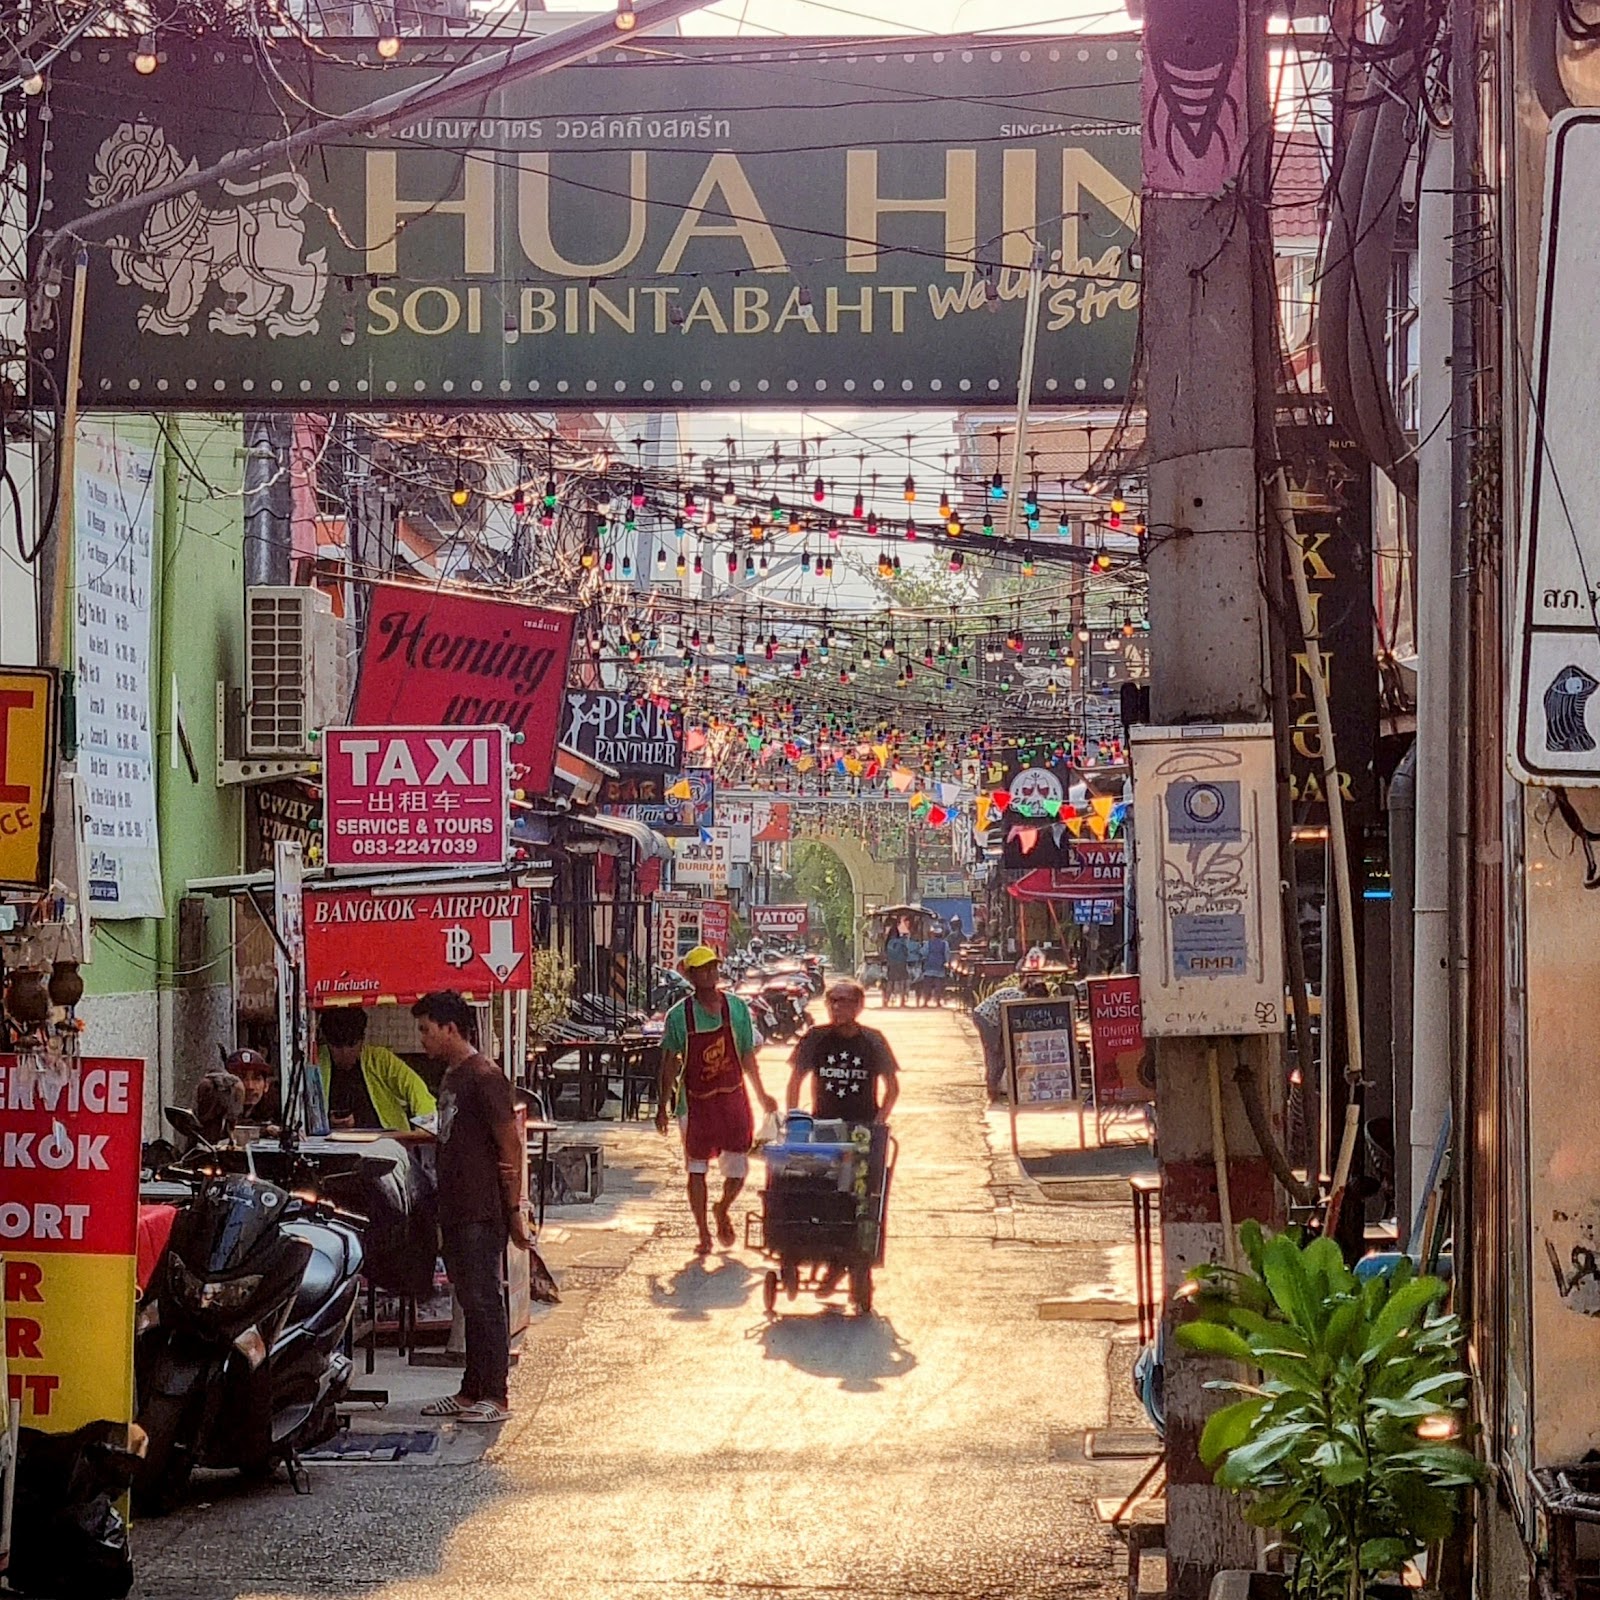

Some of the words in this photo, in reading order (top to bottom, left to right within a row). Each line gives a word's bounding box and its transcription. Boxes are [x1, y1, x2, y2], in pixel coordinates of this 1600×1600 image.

[365, 149, 790, 278] HUA
[845, 148, 1141, 276] HIN
[366, 286, 481, 335] SOI
[520, 286, 918, 335] BINTABAHT
[378, 610, 556, 697] Heming
[595, 695, 678, 744] PINK
[339, 738, 490, 786] TAXI
[595, 740, 676, 768] PANTHER
[367, 790, 461, 814] 出租车
[336, 818, 410, 835] SERVICE
[415, 818, 429, 834] &
[434, 817, 494, 834] TOURS
[352, 838, 478, 855] 083-2247039
[1086, 851, 1105, 865] YA
[1108, 851, 1126, 865] YA
[1093, 866, 1121, 879] BAR
[754, 911, 805, 924] TATTOO
[1190, 956, 1234, 969] AMA
[314, 979, 331, 992] All
[333, 977, 380, 992] Inclusive
[1102, 991, 1132, 1006] LIVE
[1096, 1004, 1140, 1019] MUSIC
